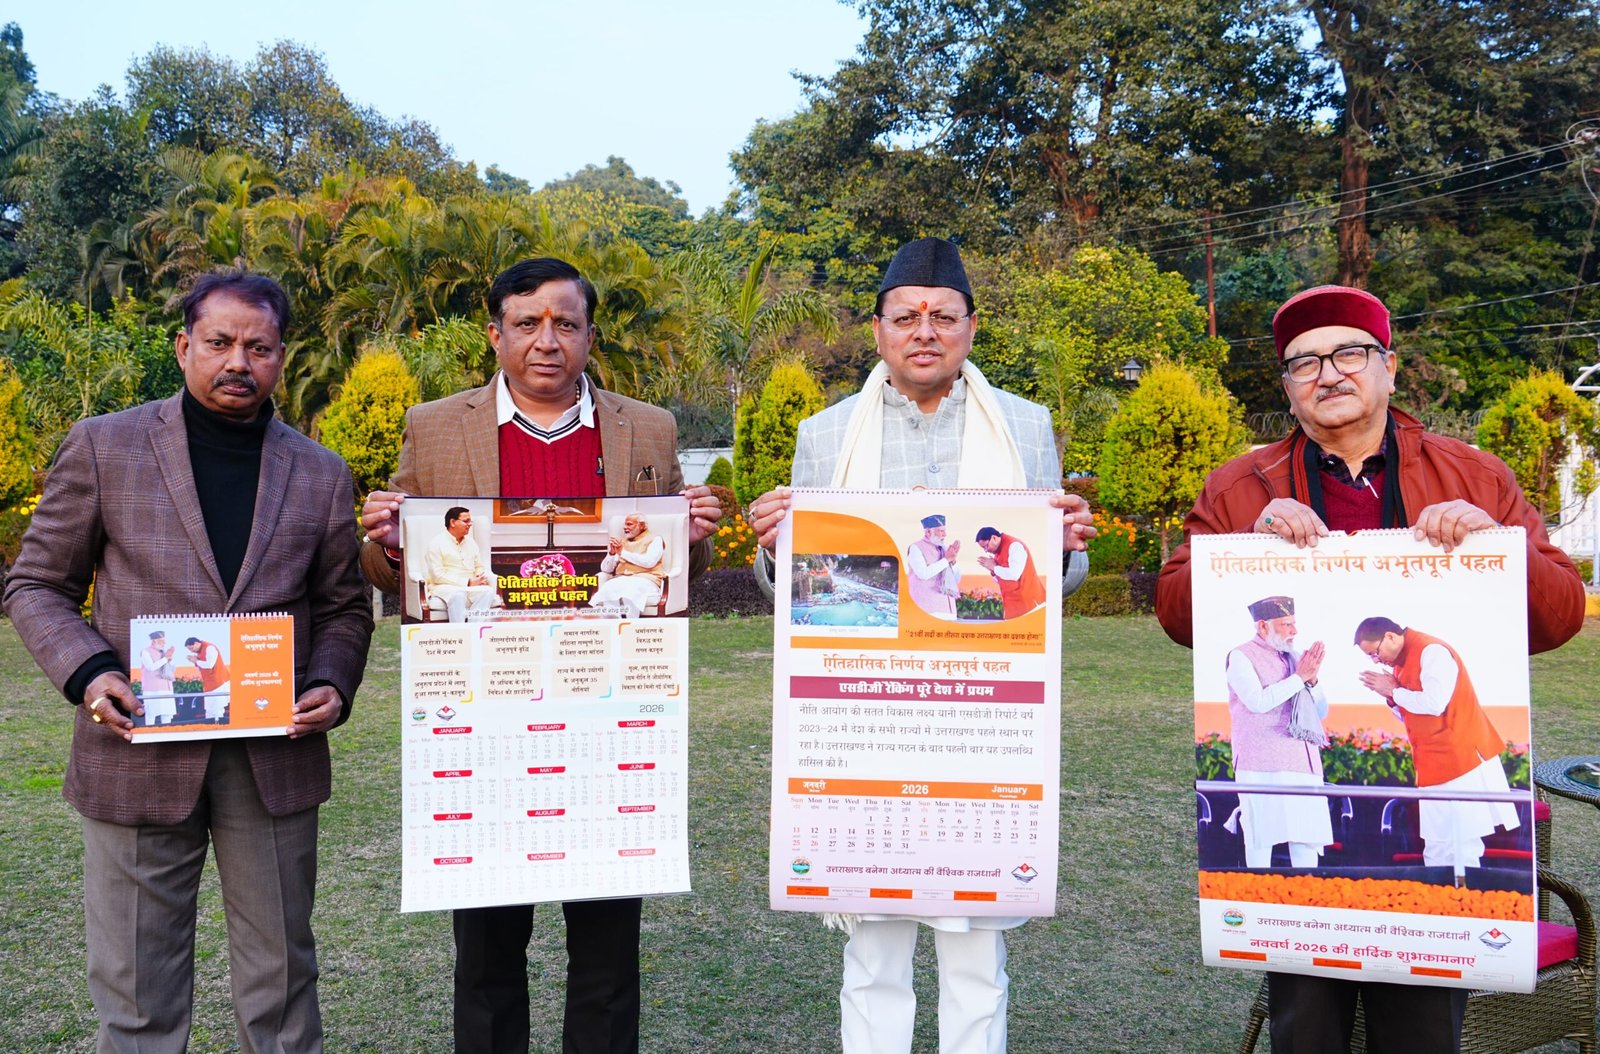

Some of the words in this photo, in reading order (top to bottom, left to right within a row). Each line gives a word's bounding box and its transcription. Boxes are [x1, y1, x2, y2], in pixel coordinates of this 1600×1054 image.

[1210, 551, 1306, 578] ऐतिहासिक
[1312, 550, 1366, 573] निर्णय
[1373, 551, 1453, 578] अभूतपूर्व
[1460, 554, 1507, 574] पहल
[498, 576, 559, 589] ऐतिहासिक
[562, 574, 597, 587] निर्णय
[508, 590, 557, 605] अभूतपूर्व
[560, 590, 588, 601] पहल
[823, 653, 887, 673] ऐतिहासिक
[890, 654, 924, 672] निर्णय
[930, 656, 980, 677] अभूतपूर्व
[983, 661, 1011, 673] पहल
[839, 681, 882, 694] एसडीजी
[917, 682, 931, 698] पूरे
[934, 684, 952, 695] देश
[954, 682, 966, 695] में
[968, 684, 994, 696] प्रथम
[640, 704, 664, 713] 2026
[800, 704, 817, 715] नीति
[822, 704, 847, 715] आयोग
[851, 705, 860, 716] की
[864, 707, 883, 716] सतत
[887, 706, 913, 717] विकास
[916, 708, 934, 717] लक्ष्य
[938, 707, 956, 718] यानी
[960, 708, 992, 720] एसडीजी
[995, 708, 1017, 719] रिपोर्ट
[1021, 709, 1033, 720] वर्ष
[851, 723, 865, 734] देश
[868, 723, 876, 733] के
[879, 723, 896, 734] सभी
[900, 724, 921, 735] राज्यों
[934, 727, 974, 736] उत्तराखण्ड
[978, 726, 995, 737] पहले
[999, 729, 1019, 737] स्थान
[1022, 729, 1034, 737] पर
[800, 741, 812, 750] रहा
[825, 742, 865, 751] उत्तराखण्ड
[867, 740, 874, 751] ने
[877, 743, 895, 752] राज्य
[918, 741, 927, 753] के
[946, 742, 967, 754] पहली
[986, 746, 998, 755] यह
[1000, 744, 1033, 755] उपलब्धि
[798, 756, 823, 768] हासिल
[825, 756, 836, 768] की
[803, 780, 826, 790] जनवरी
[902, 784, 929, 795] 2026
[992, 785, 1027, 795] January
[825, 865, 863, 874] उत्तराखण्ड
[865, 864, 888, 875] बनेगा
[890, 867, 921, 875] अध्यात्म
[924, 866, 934, 876] की
[936, 866, 964, 876] वैश्विक
[967, 868, 1001, 878] राजधानी
[1257, 917, 1301, 928] उत्तराखण्ड
[1304, 919, 1330, 930] बनेगा
[1334, 922, 1371, 933] अध्यात्म
[1374, 924, 1386, 934] की
[1390, 925, 1425, 938] वैश्विक
[1428, 930, 1470, 941] राजधानी
[1250, 938, 1289, 950] नववर्ष
[1294, 942, 1328, 953] 2026
[1332, 943, 1349, 954] की
[1353, 945, 1392, 958] हार्दिक
[1396, 950, 1477, 968] शुभकामनाएं
